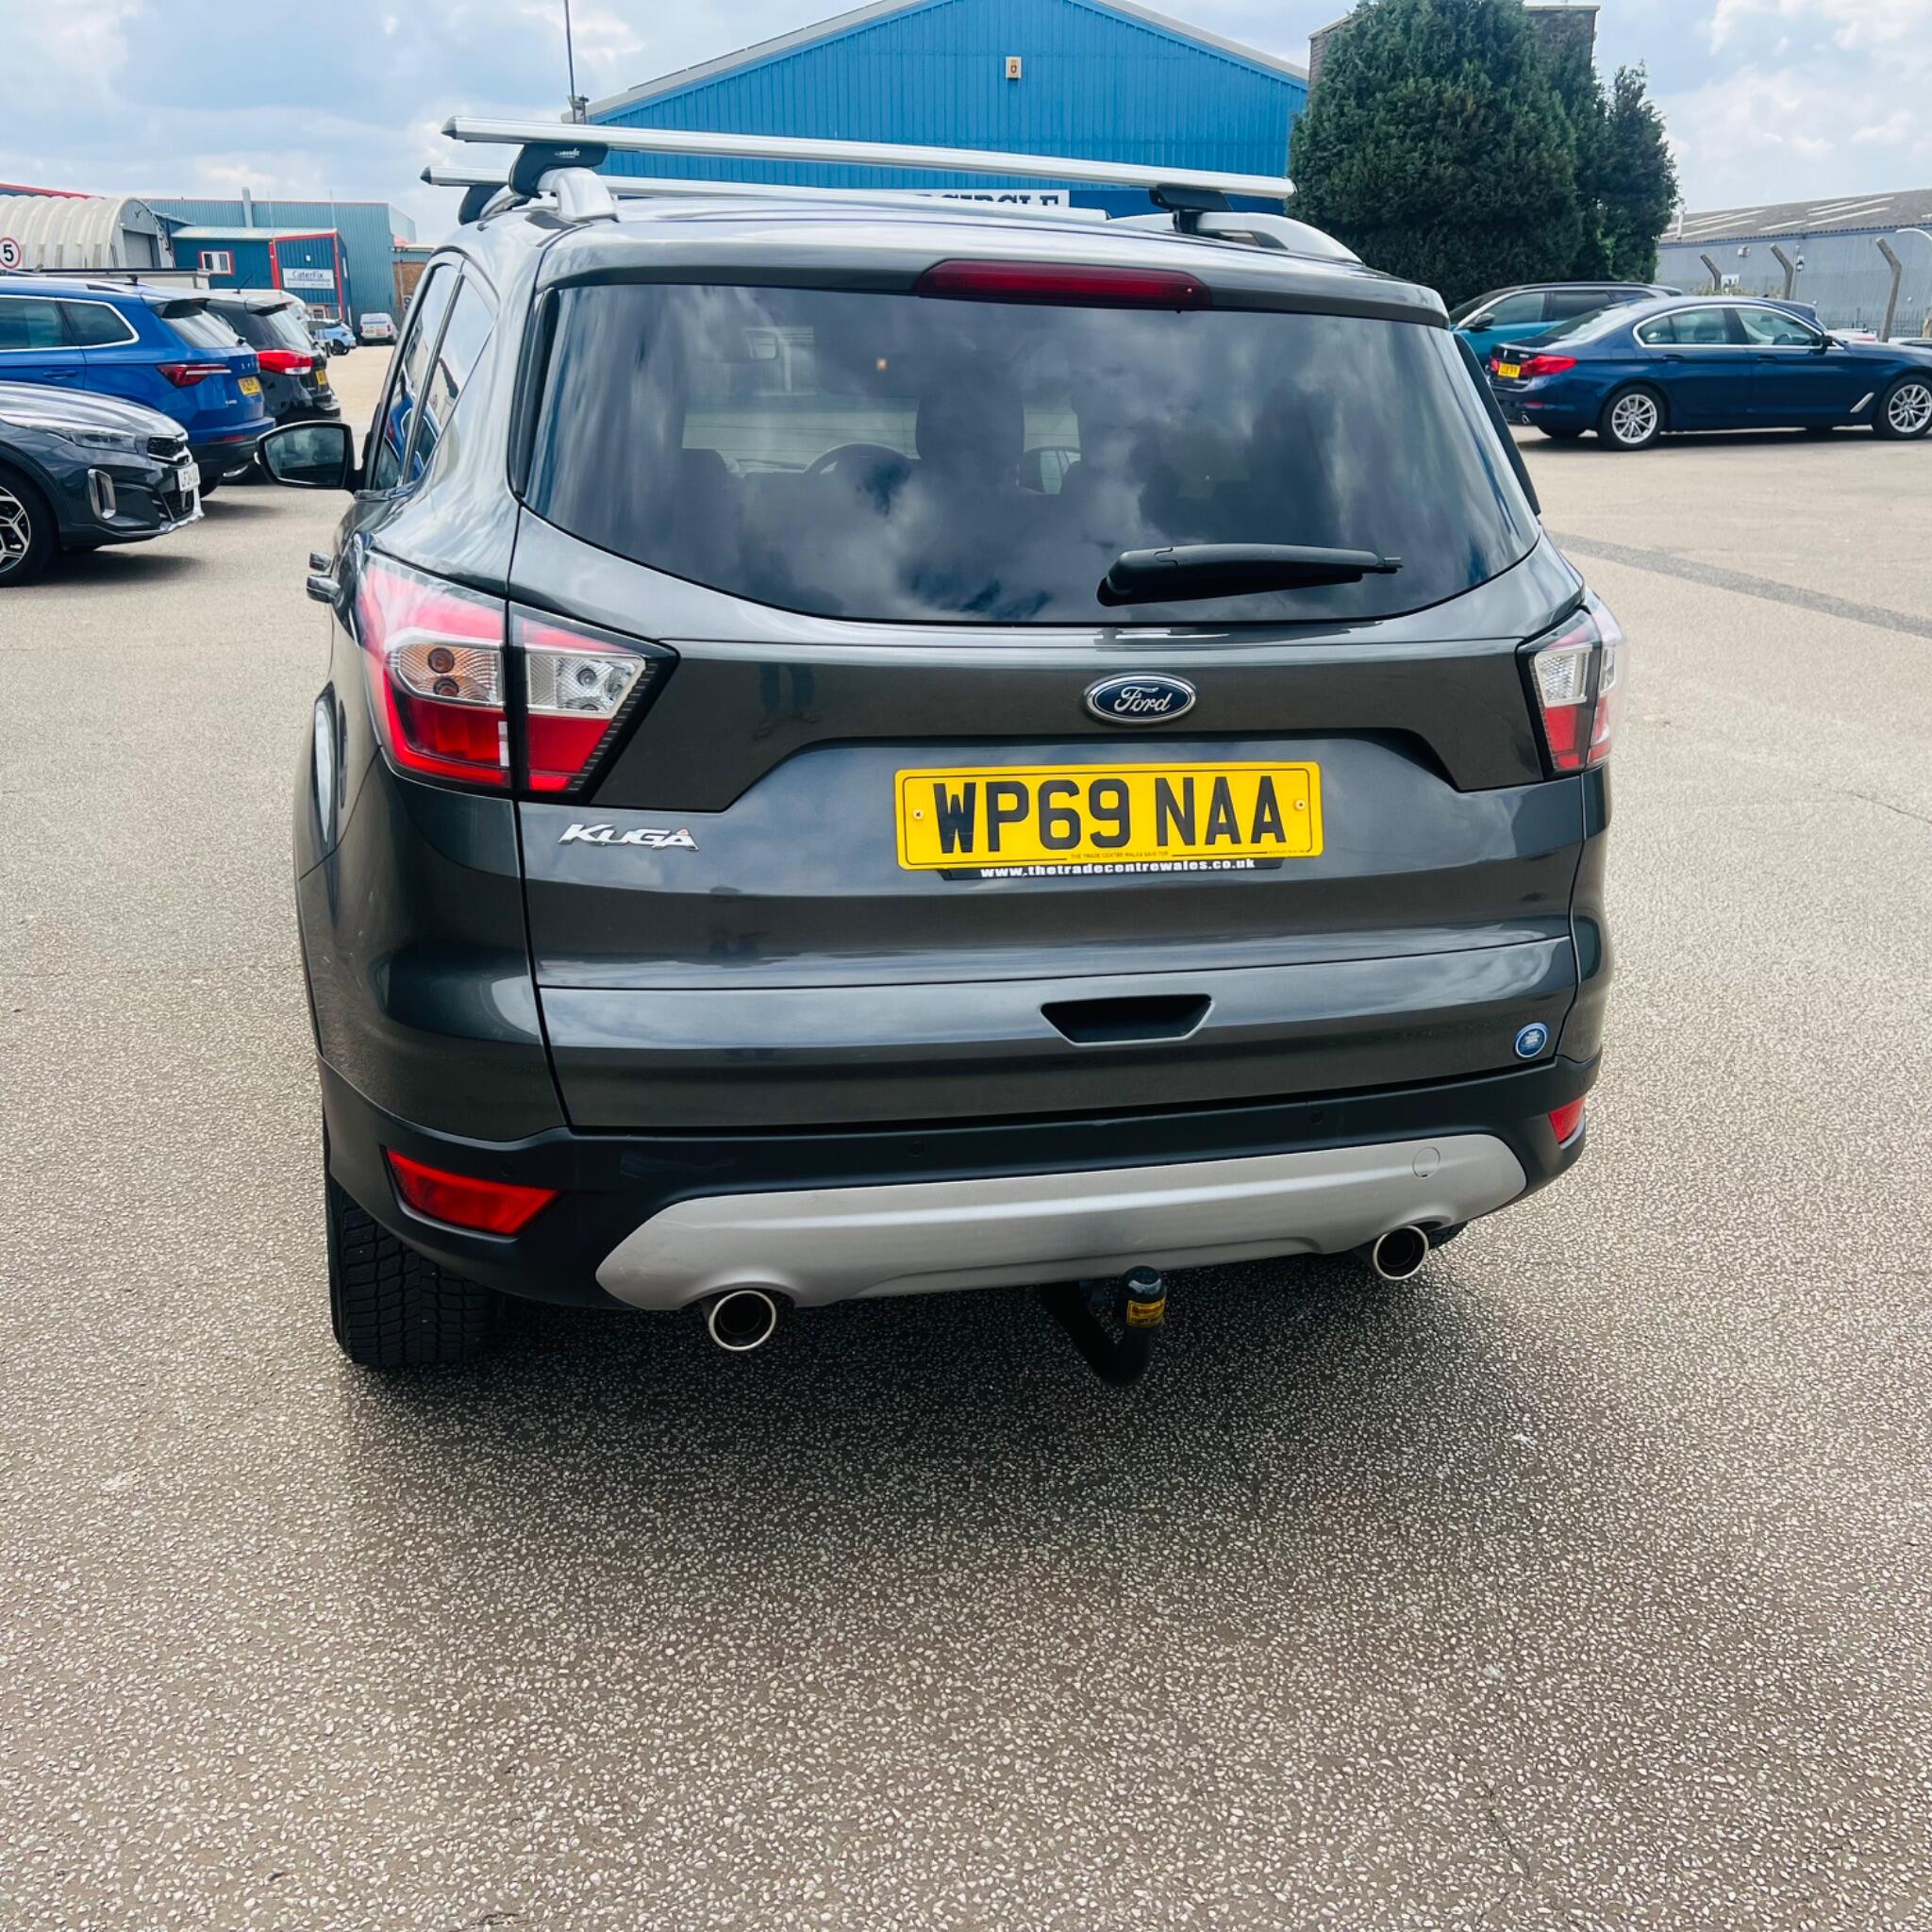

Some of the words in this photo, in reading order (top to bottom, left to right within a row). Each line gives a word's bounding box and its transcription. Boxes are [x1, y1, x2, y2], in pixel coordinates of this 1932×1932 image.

[4, 244, 14, 262] 5
[1114, 686, 1173, 711] Ford
[933, 778, 1130, 854] WP69
[1155, 775, 1287, 846] NAA
[558, 824, 699, 850] KUGA
[980, 858, 1256, 877] www.thetradecentrewales.co.uk
